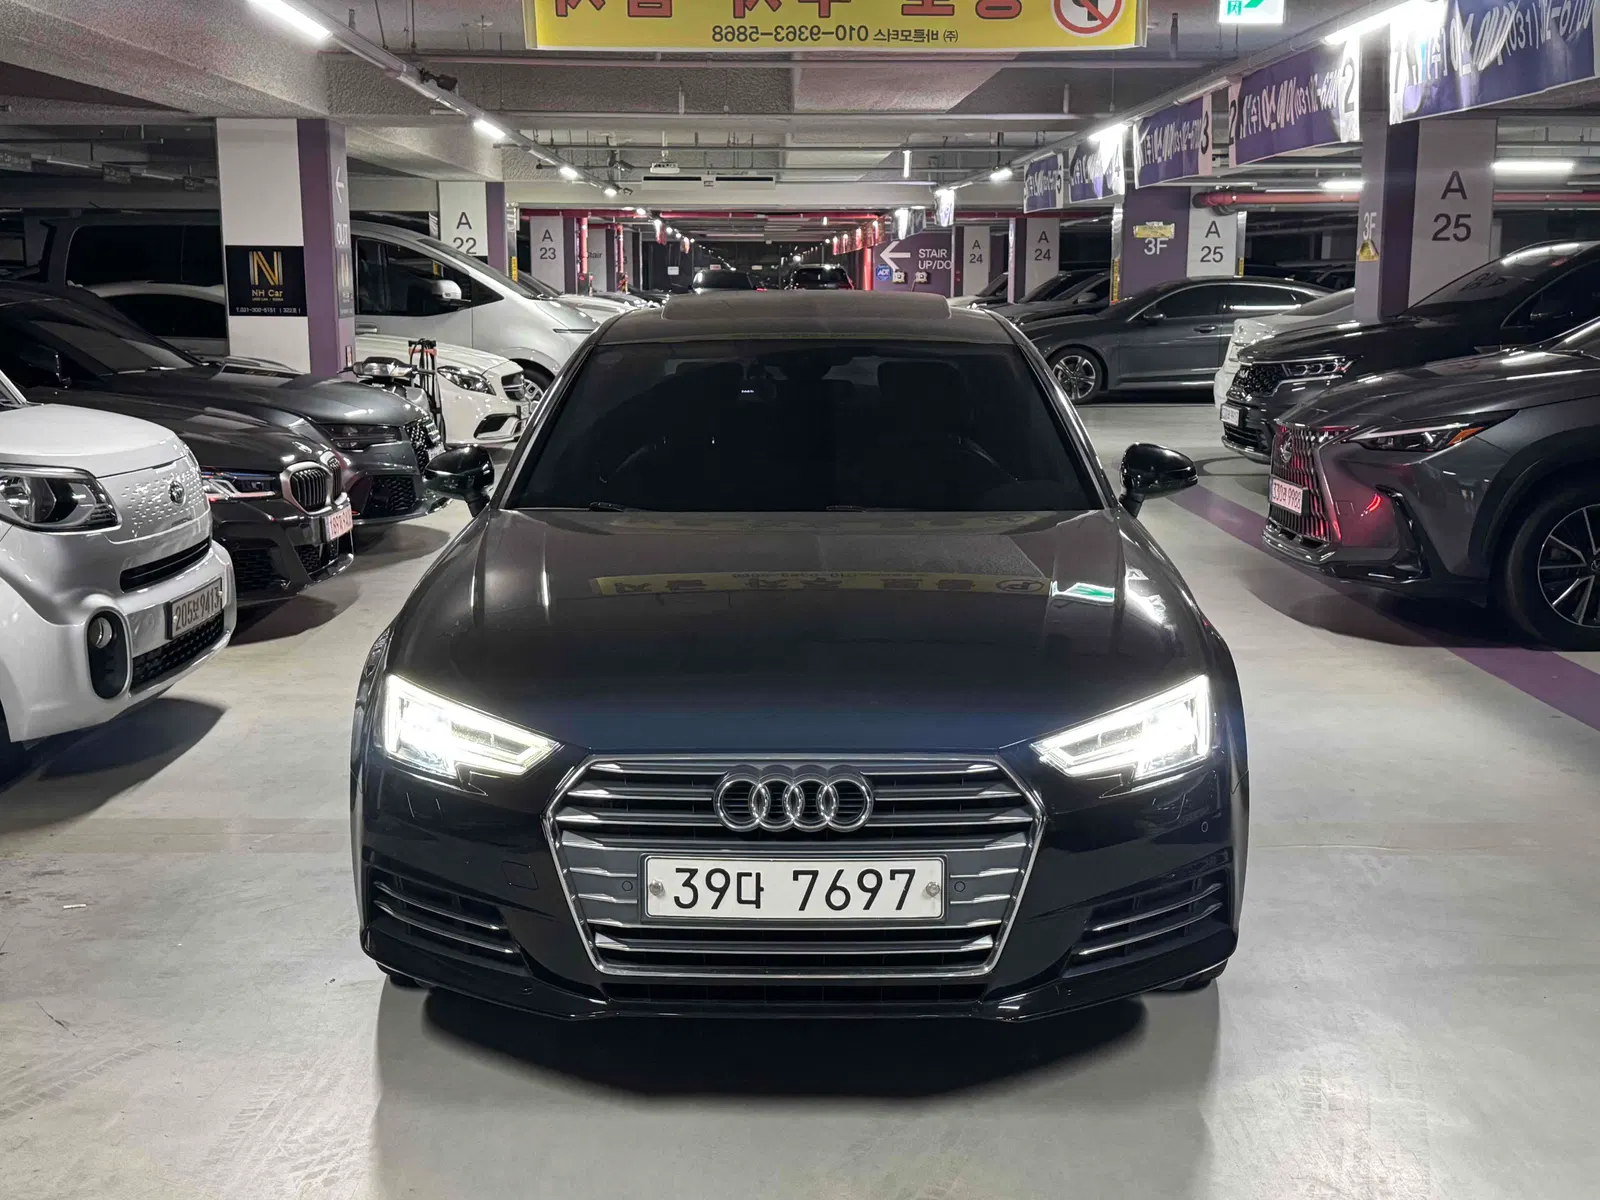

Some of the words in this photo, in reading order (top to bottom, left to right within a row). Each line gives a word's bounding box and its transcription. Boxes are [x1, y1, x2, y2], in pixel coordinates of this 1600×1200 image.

[1201, 111, 1210, 155] 3
[1441, 170, 1468, 200] A
[456, 211, 473, 230] A
[1204, 220, 1221, 239] A
[1362, 212, 1378, 241] 3F
[1431, 213, 1472, 242] 25
[336, 222, 349, 245] OUT
[541, 229, 554, 243] A
[1037, 230, 1050, 244] A
[539, 247, 557, 260] 23
[918, 248, 948, 259] STAIR
[971, 239, 982, 250] A
[1143, 237, 1169, 256] 3F
[1199, 245, 1224, 263] 25
[969, 253, 983, 264] 24
[1034, 248, 1052, 261] 24
[249, 250, 284, 286] N
[251, 289, 265, 297] NH
[267, 289, 284, 298] Car
[673, 867, 765, 909] 39다
[792, 868, 917, 912] 7697
